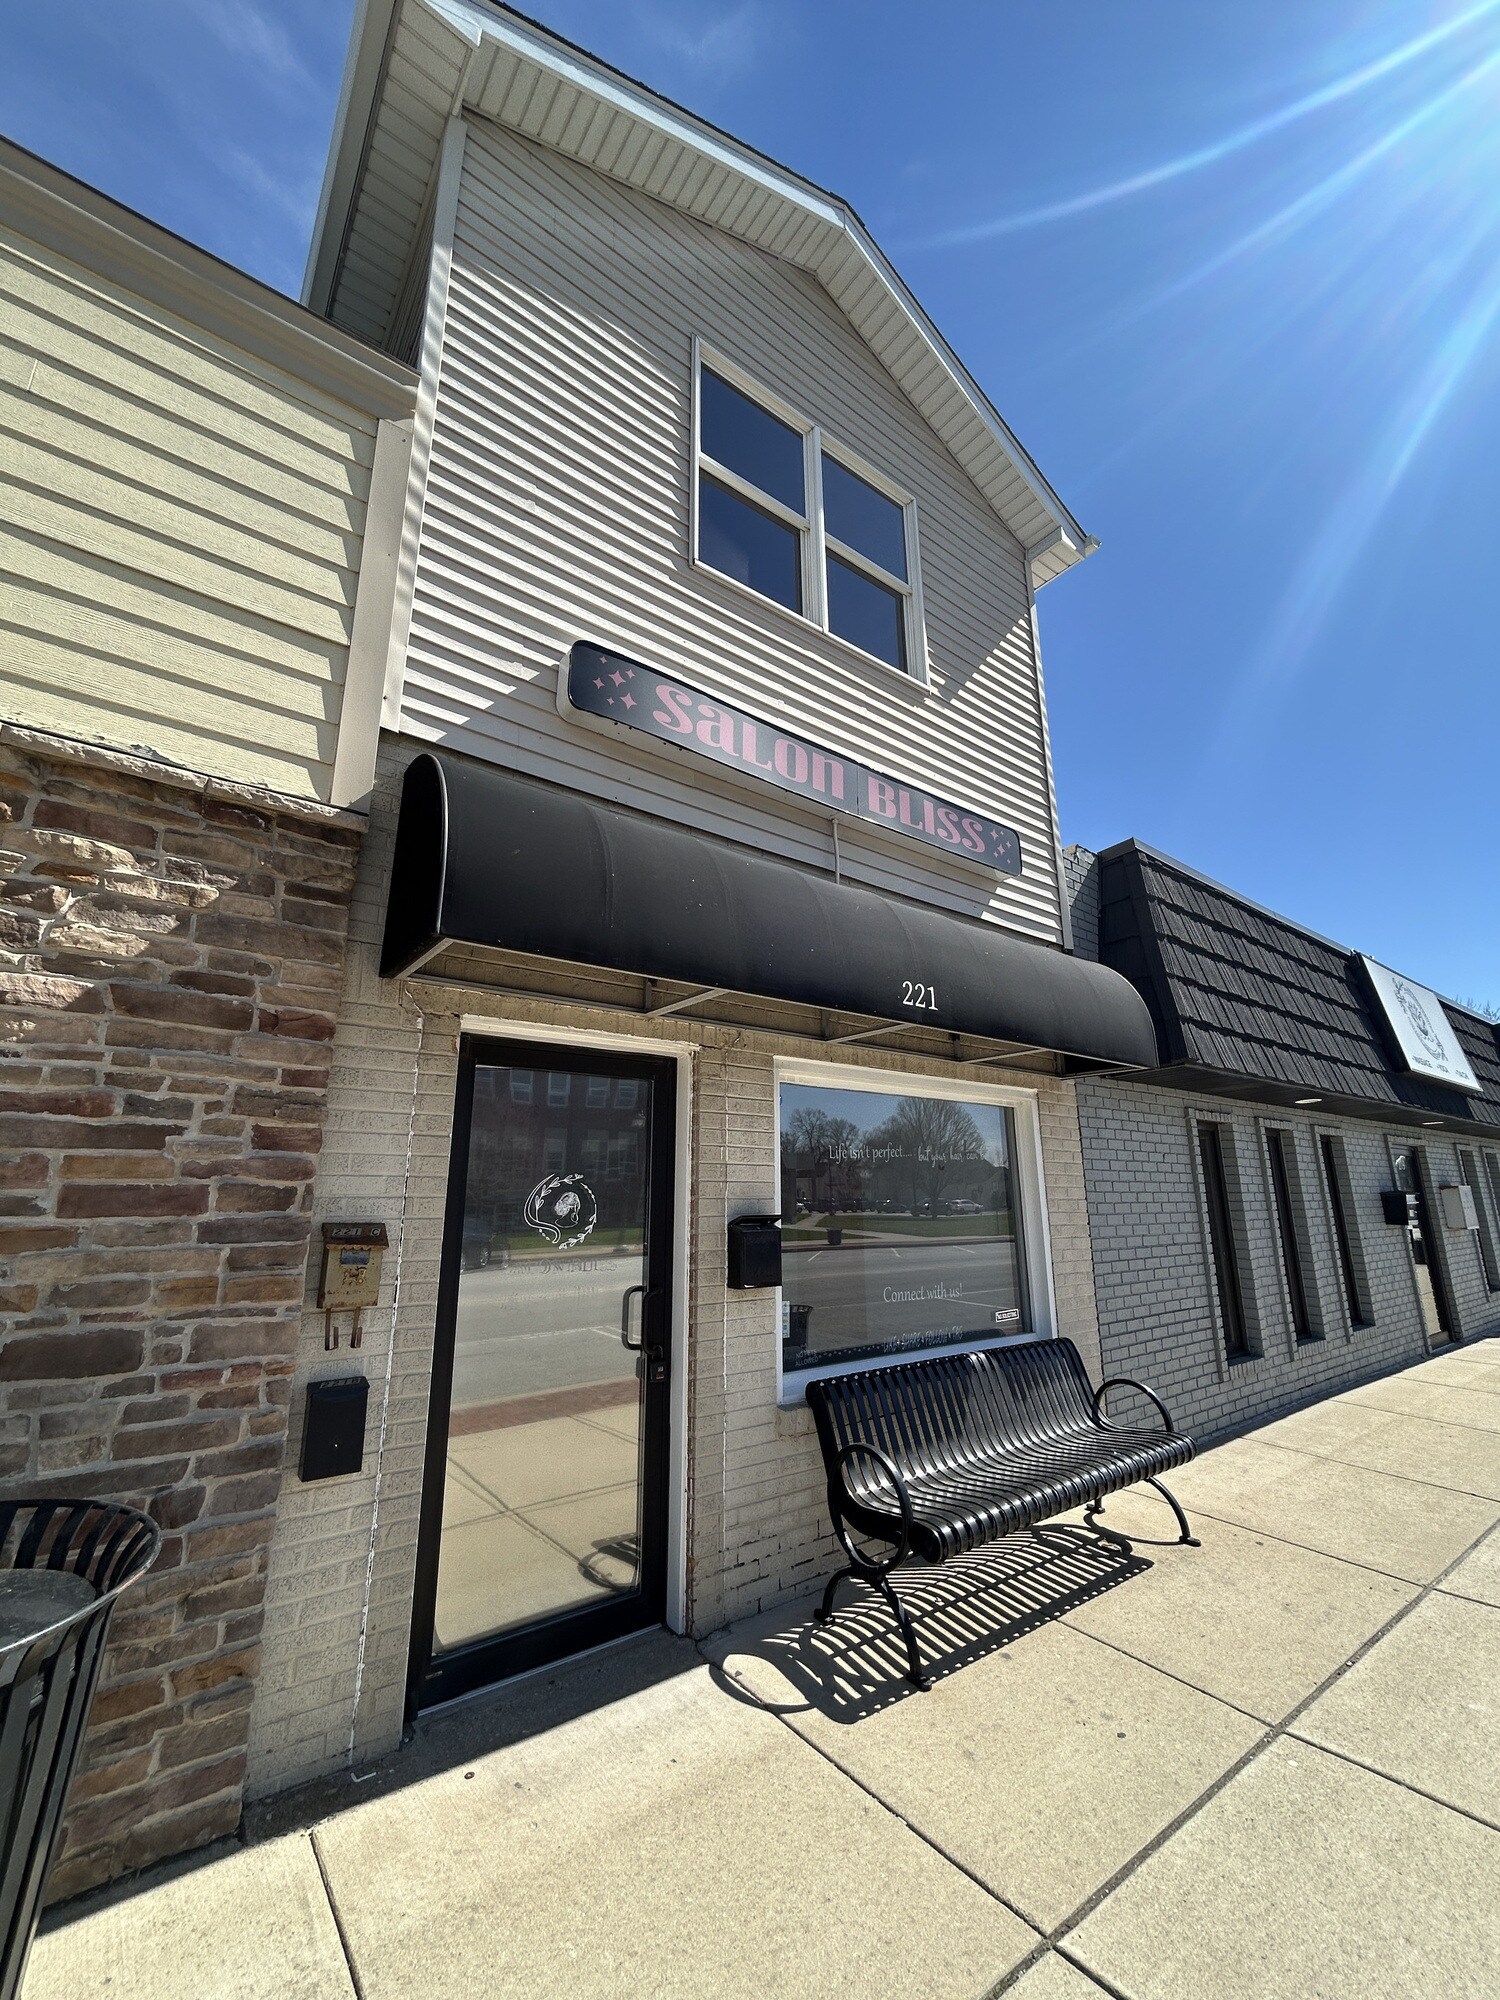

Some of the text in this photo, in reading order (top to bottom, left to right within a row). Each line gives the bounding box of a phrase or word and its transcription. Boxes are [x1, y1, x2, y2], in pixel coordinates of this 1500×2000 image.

[867, 775, 986, 853] BLISS
[902, 980, 939, 1011] 221
[829, 1142, 847, 1164] Life
[849, 1144, 870, 1161] isn't
[333, 1227, 380, 1236] 221 C
[883, 1281, 963, 1303] Connect with us!
